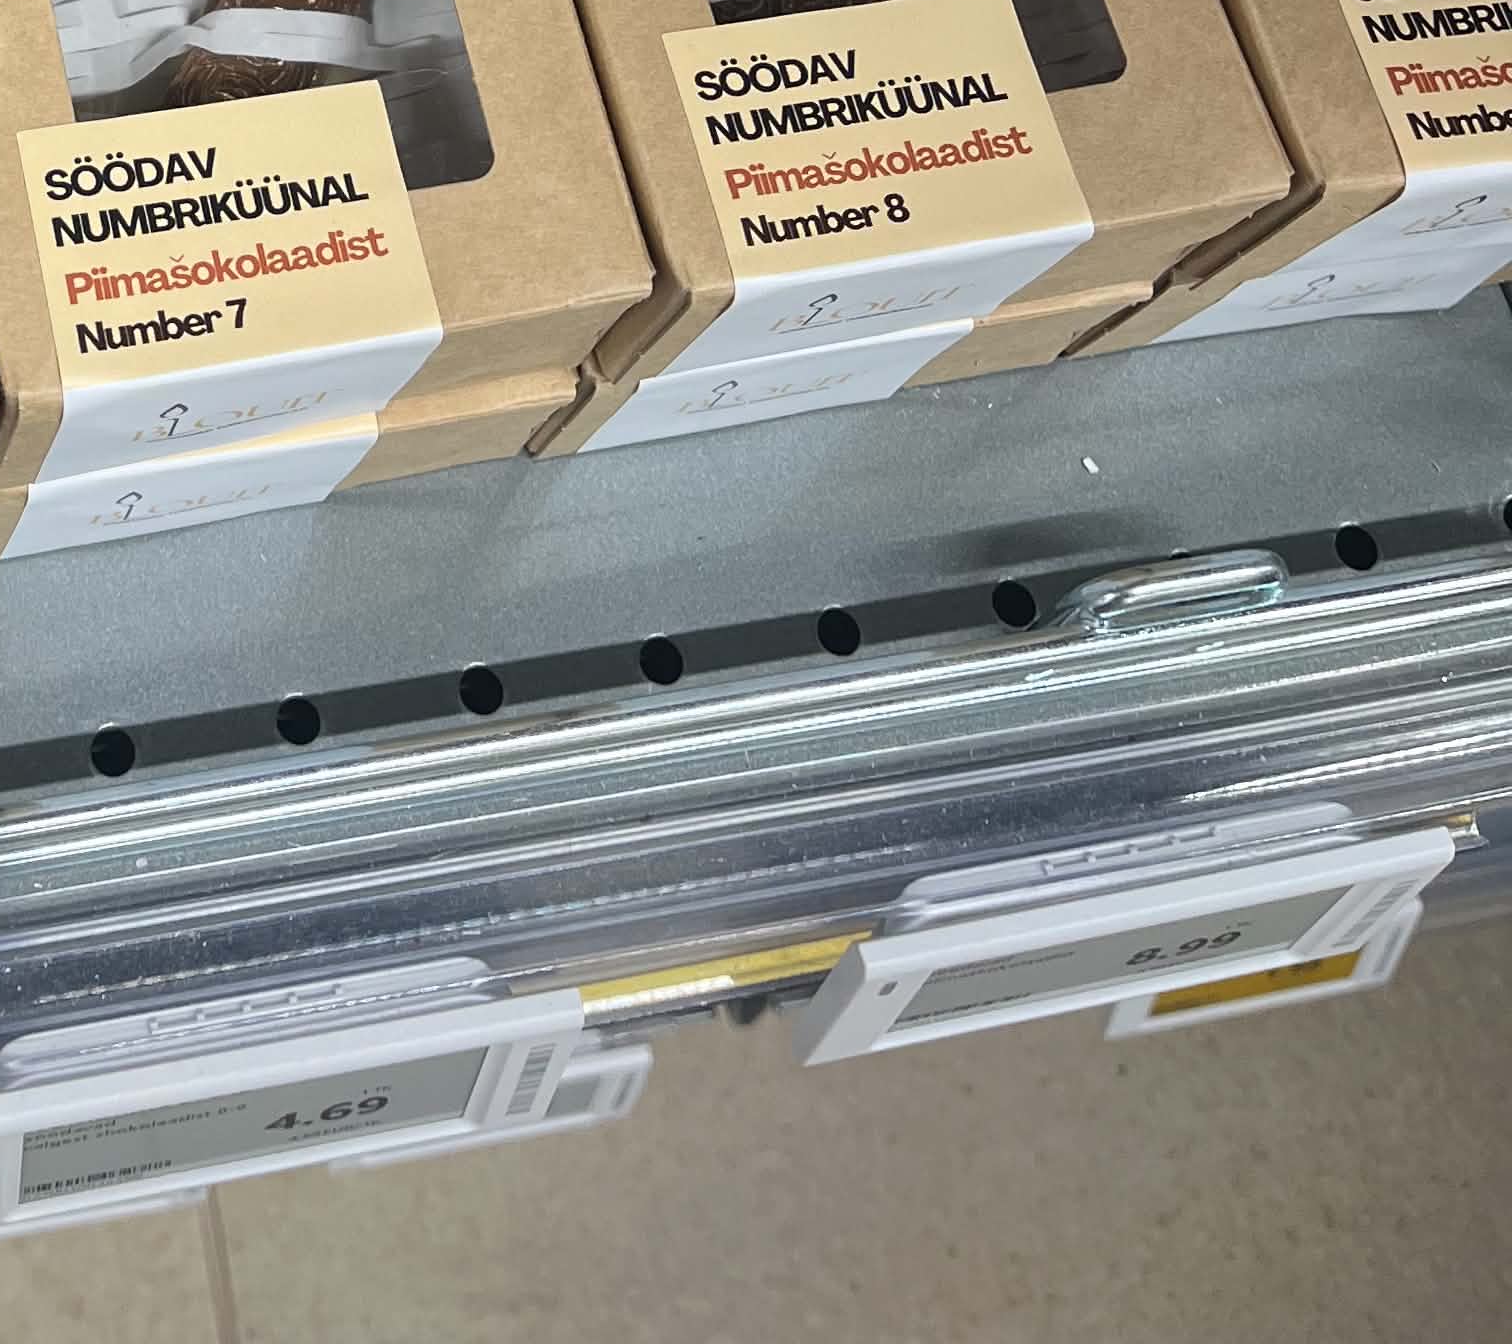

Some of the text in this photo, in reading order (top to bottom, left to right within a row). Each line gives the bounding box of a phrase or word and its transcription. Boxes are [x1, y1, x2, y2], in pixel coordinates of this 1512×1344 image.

[694, 48, 857, 102] SÖÖDAV
[704, 72, 1009, 146] NUMBRIKÜÜNAL
[44, 146, 217, 201] SÖÖDAV
[723, 126, 1034, 200] Piimašokolaadist
[51, 172, 370, 248] NUMBRIKÜÜNAL
[739, 192, 911, 247] Number 8
[64, 227, 390, 305] Piimašokolaadist
[75, 297, 248, 355] Number 7
[1126, 930, 1241, 965] 8.99
[264, 1096, 389, 1130] 4.69
